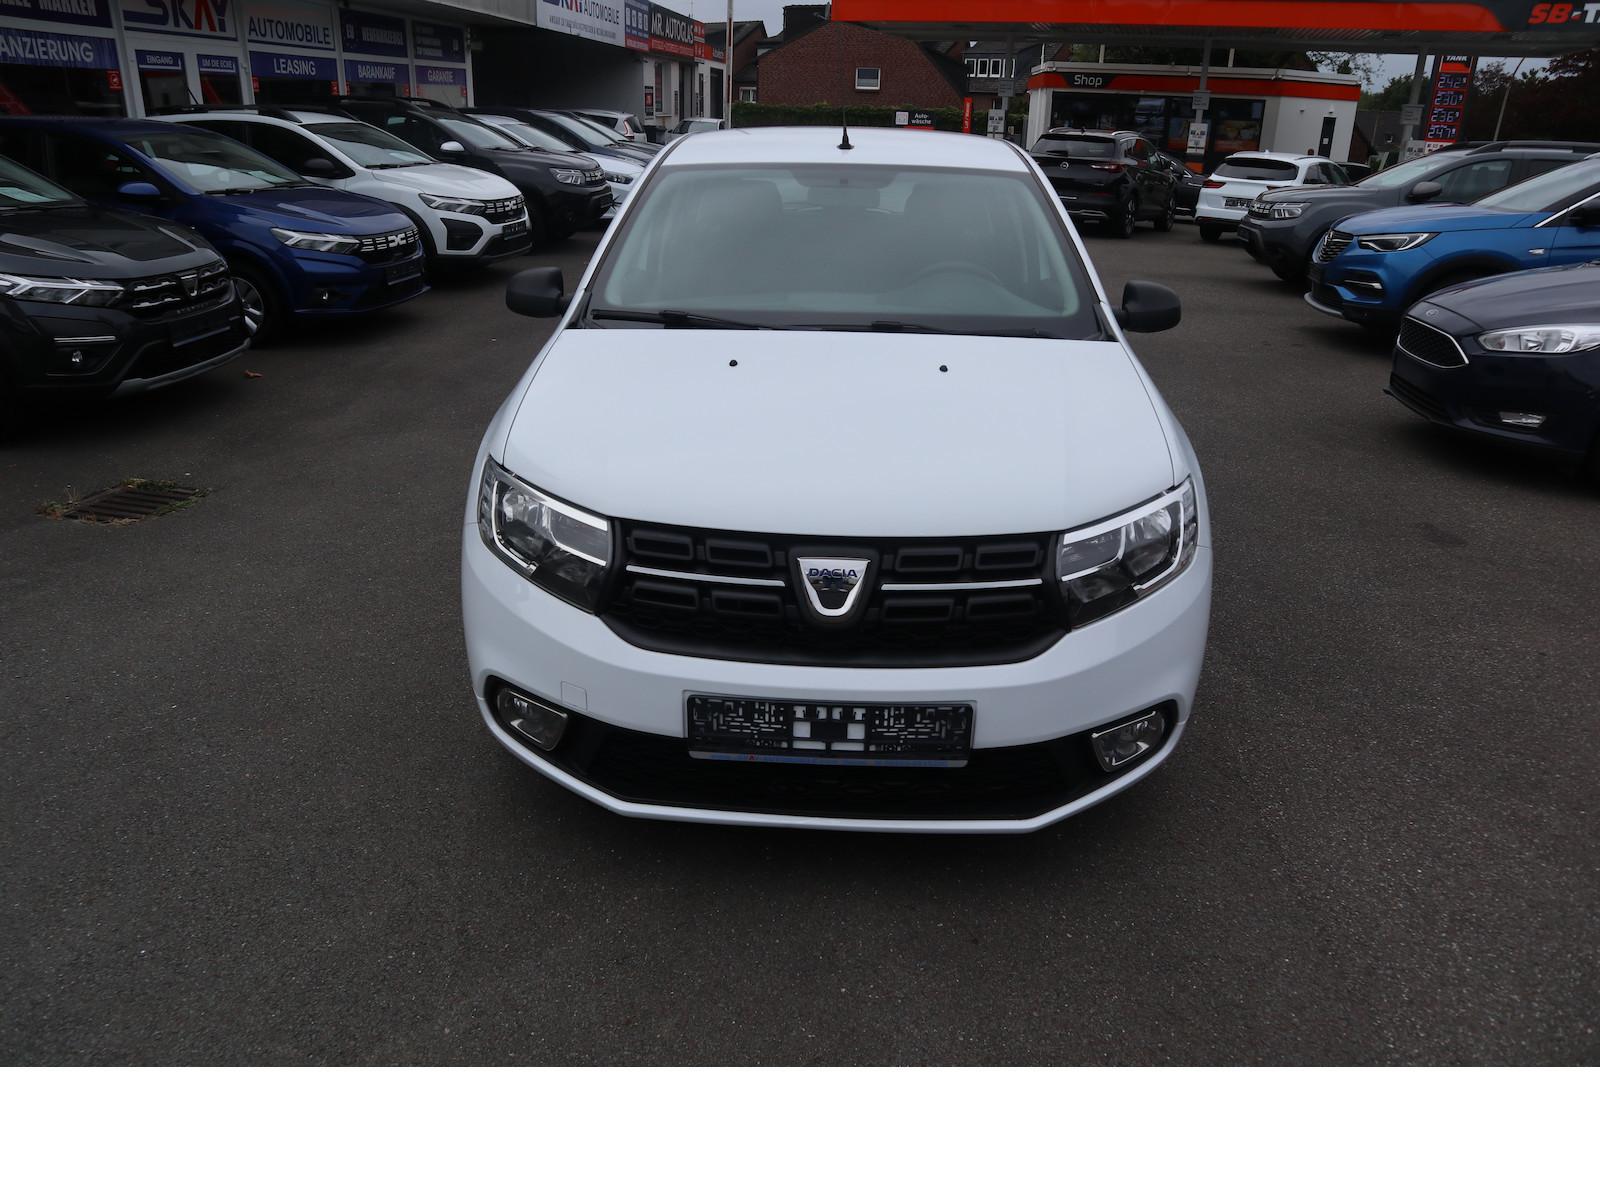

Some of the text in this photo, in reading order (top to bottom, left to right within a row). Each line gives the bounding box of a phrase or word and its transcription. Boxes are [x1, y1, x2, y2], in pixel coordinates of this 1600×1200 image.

[1527, 2, 1600, 25] SB-T
[248, 16, 331, 45] AUTOMOBILE
[665, 17, 694, 45] AUTOGLAS
[146, 55, 174, 65] EINGANG
[273, 57, 317, 76] LEASING
[358, 64, 396, 80] BARANKAUF
[1074, 74, 1103, 88] Shop
[808, 568, 858, 578] DACIA
